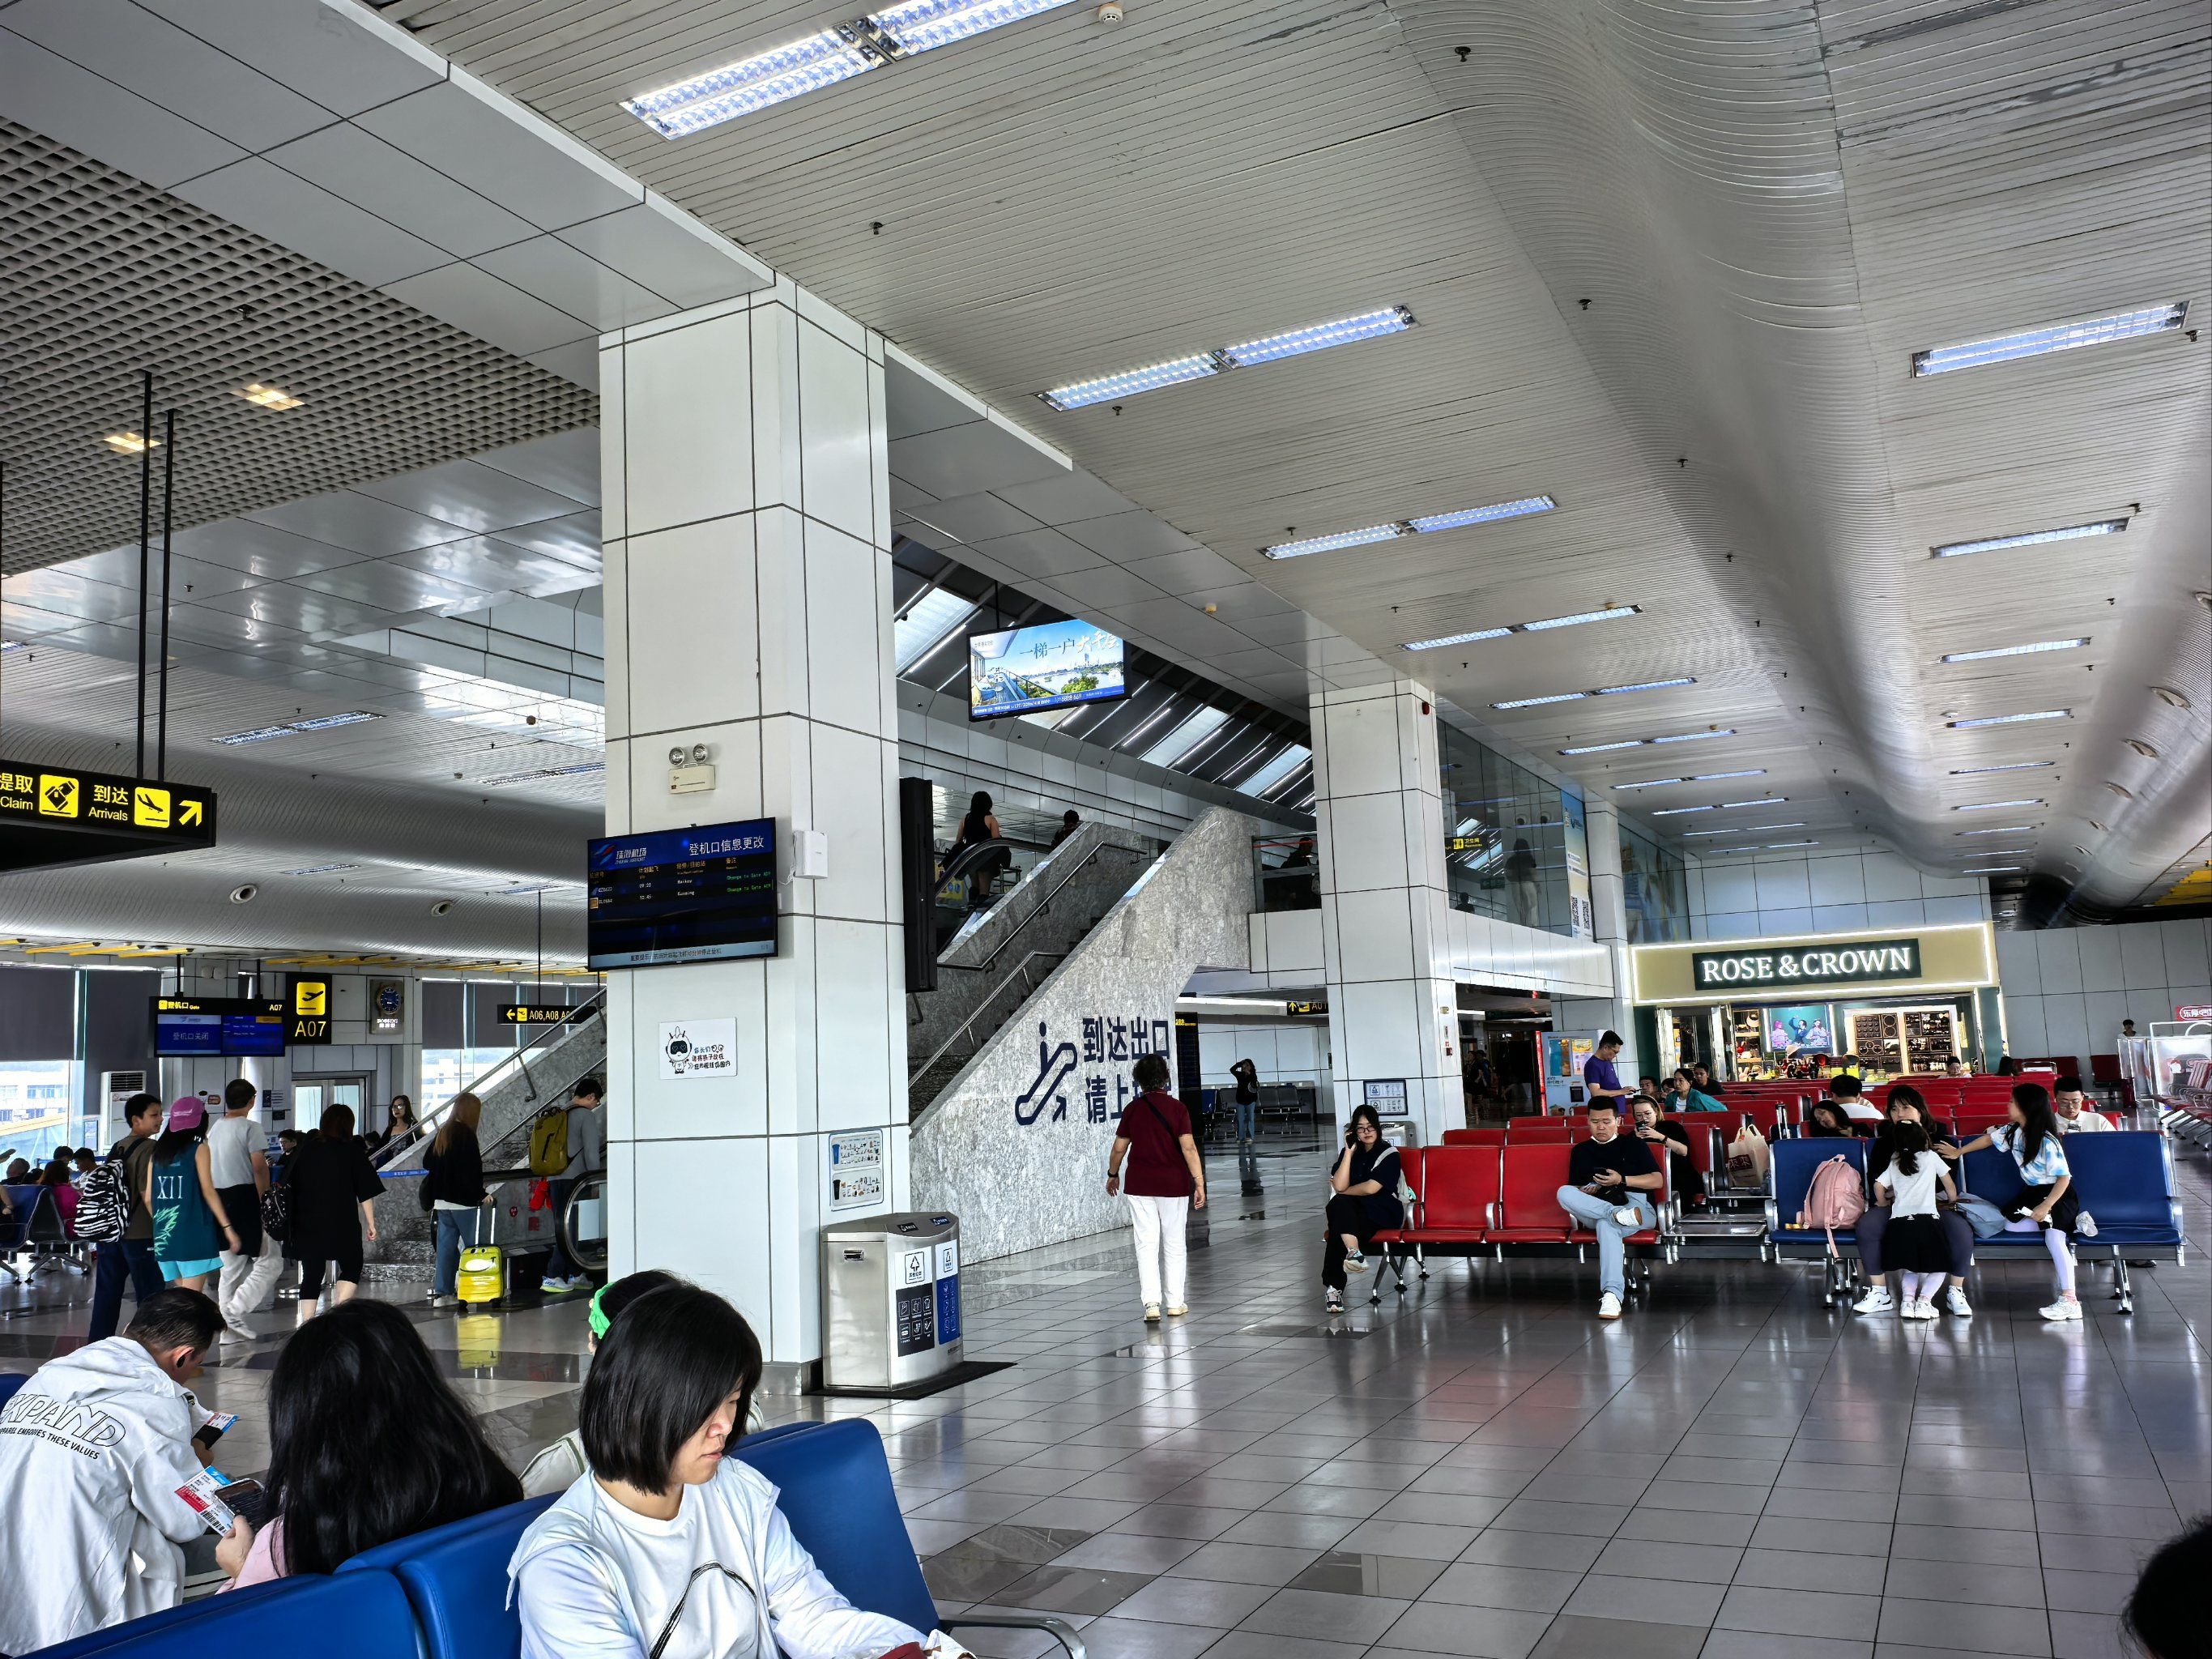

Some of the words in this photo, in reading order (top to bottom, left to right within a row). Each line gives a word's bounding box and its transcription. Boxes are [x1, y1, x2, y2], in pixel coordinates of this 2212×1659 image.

[0, 773, 33, 794] 提取
[93, 784, 129, 805] 到达
[0, 796, 33, 810] Claim
[88, 807, 128, 821] Arrivals
[689, 836, 765, 856] 登机口信息更改
[1701, 957, 1774, 983] ROSE
[1779, 953, 1801, 977] &
[1802, 947, 1911, 975] CROWN
[269, 1004, 283, 1012] A07
[173, 1031, 209, 1041] 登机口关闭
[295, 1021, 326, 1038] A07
[1082, 1016, 1170, 1063] 到达出口
[157, 1175, 183, 1199] XII
[46, 1433, 71, 1448] THESE
[70, 1441, 100, 1460] VALUES
